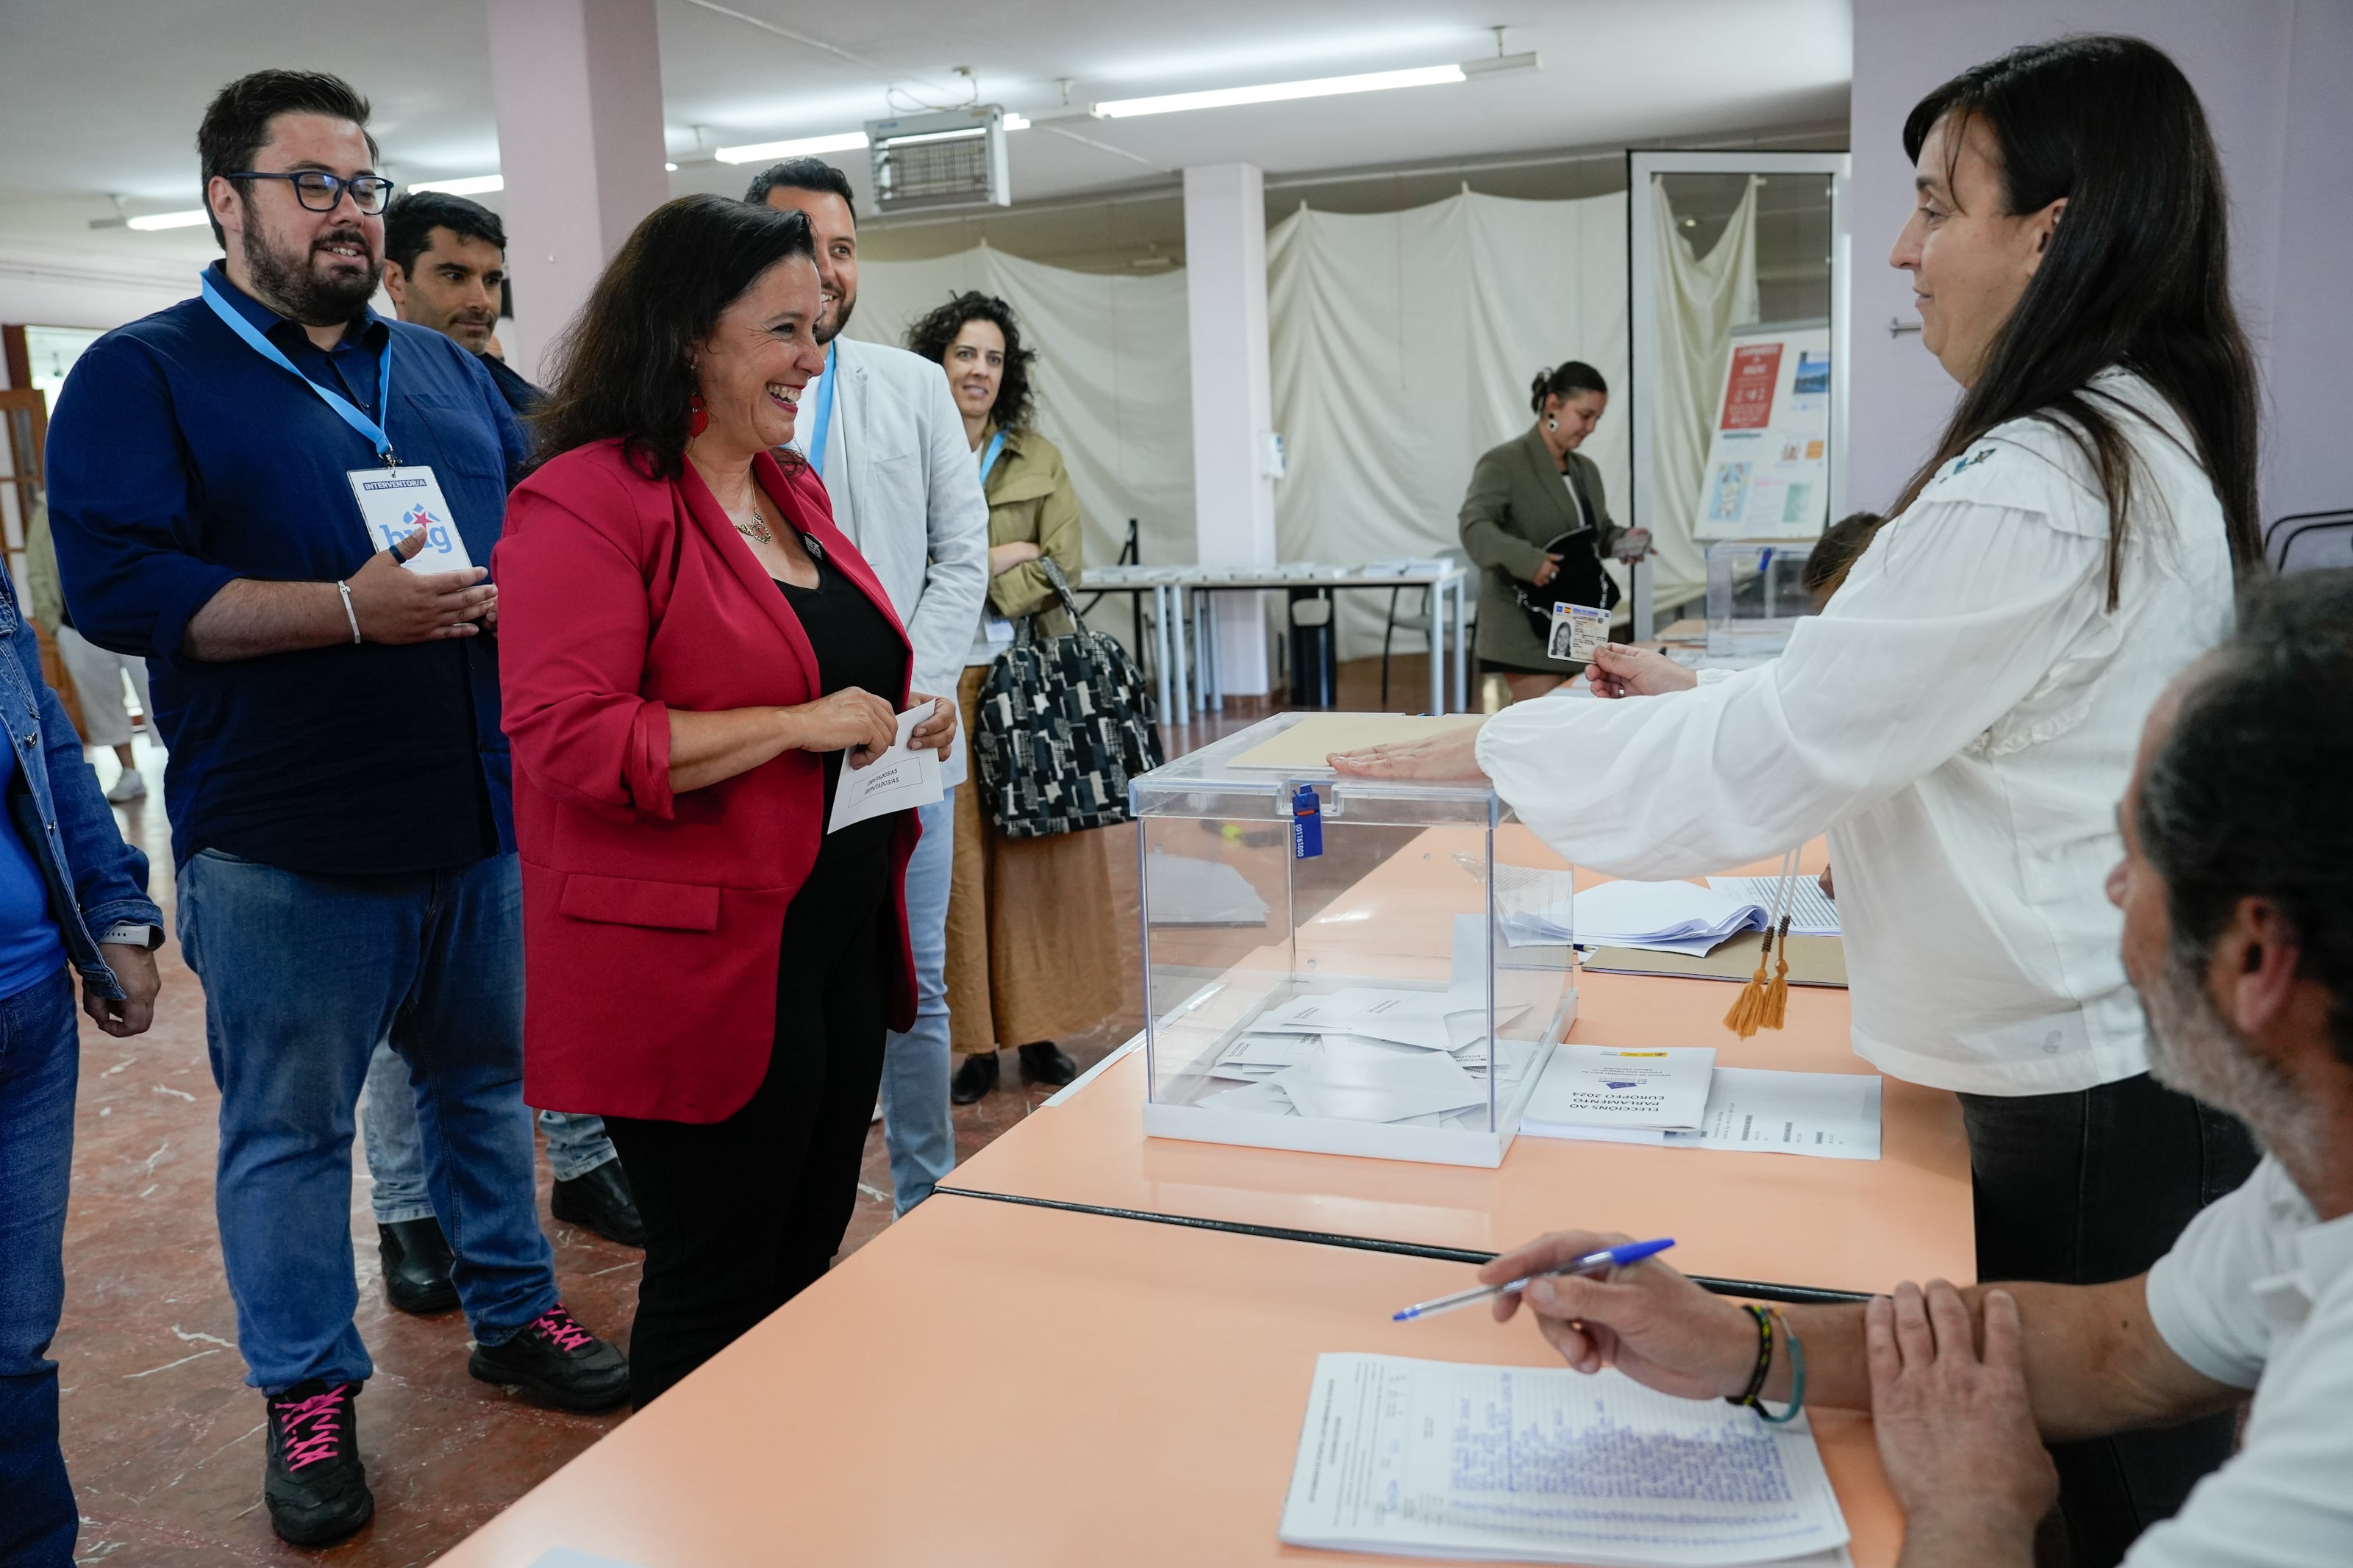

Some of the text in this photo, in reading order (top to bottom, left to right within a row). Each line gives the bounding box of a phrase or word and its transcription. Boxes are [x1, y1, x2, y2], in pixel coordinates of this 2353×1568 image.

[364, 479, 426, 490] INTERVENTOR/A
[864, 777, 899, 795] DEPUTADOS/AS
[1573, 1098, 1660, 1106] PARLAMENTO
